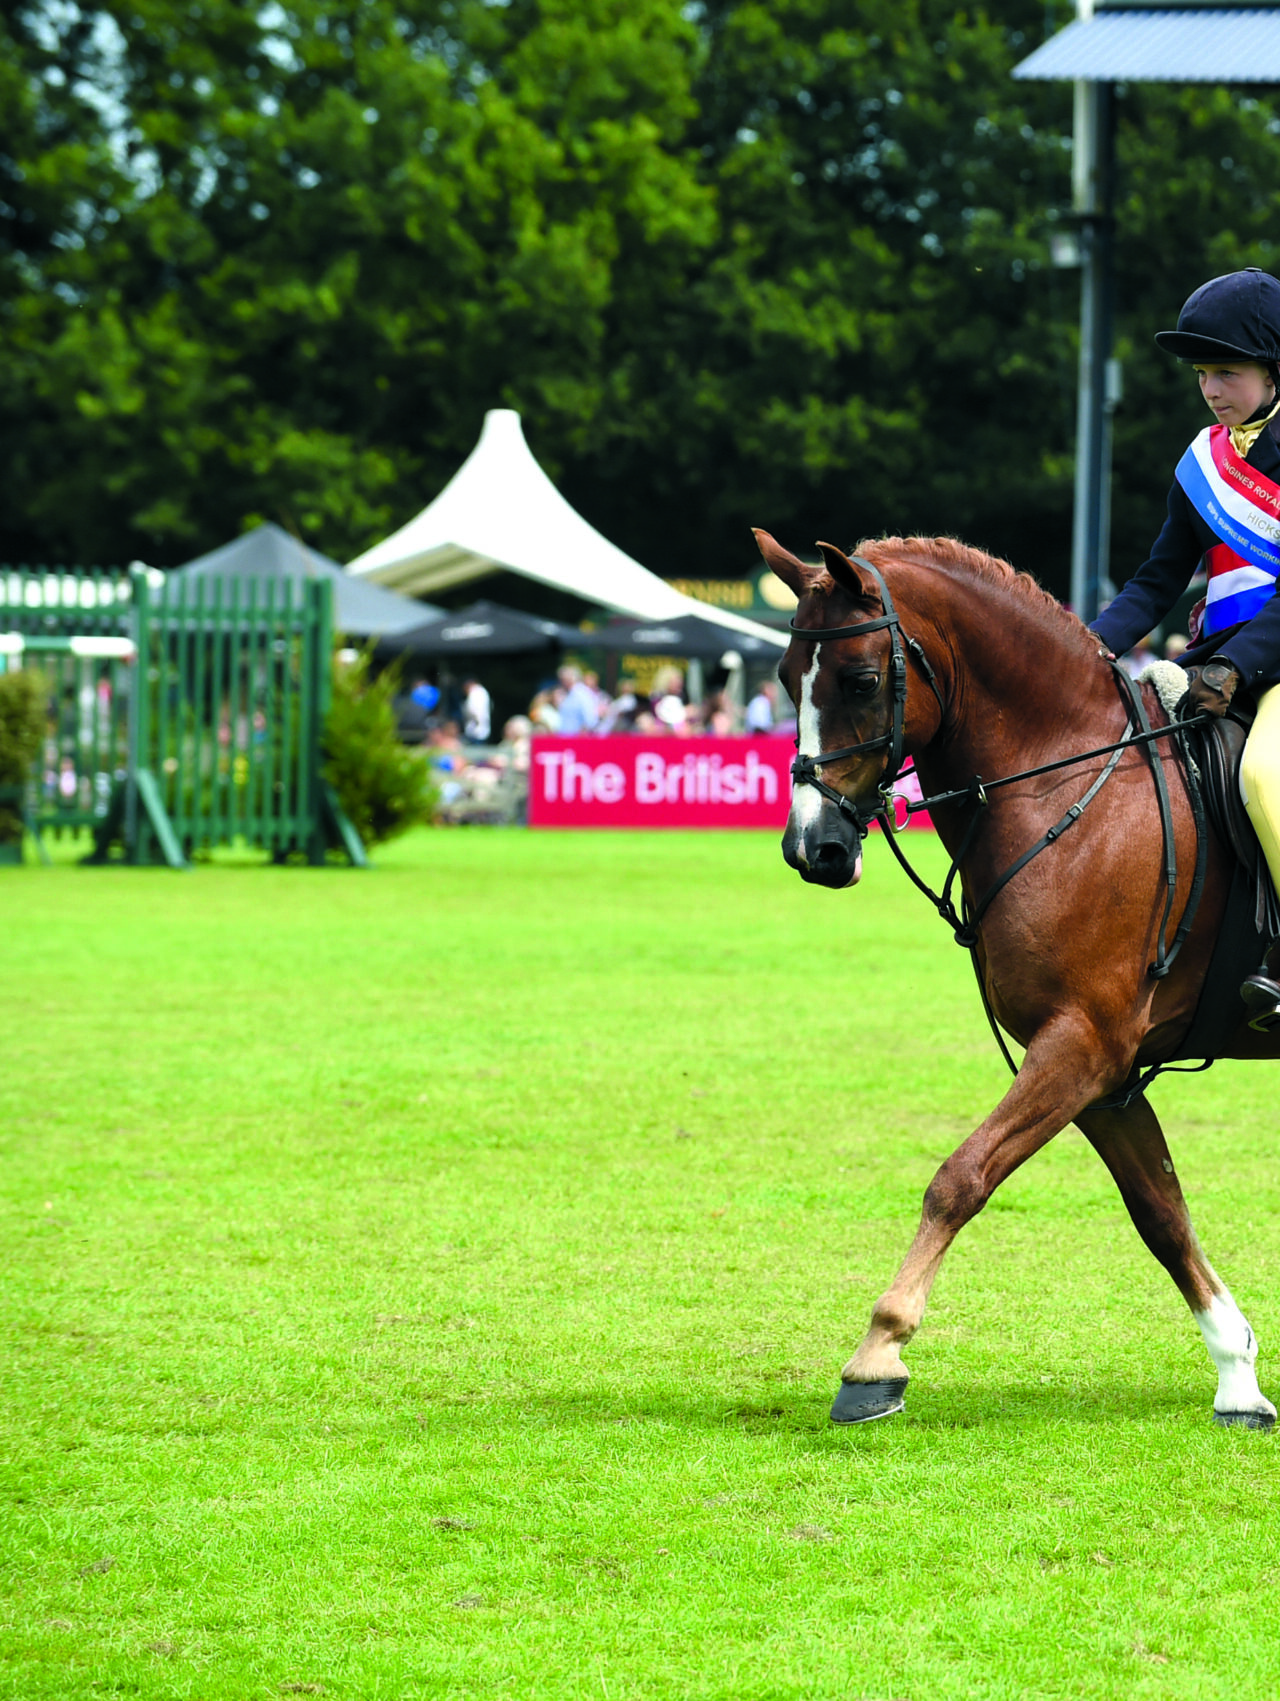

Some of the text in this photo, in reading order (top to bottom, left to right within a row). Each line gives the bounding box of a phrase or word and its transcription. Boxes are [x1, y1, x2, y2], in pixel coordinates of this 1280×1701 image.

[1253, 485, 1280, 510] ROYAL
[1217, 517, 1249, 547] SUPREME
[536, 750, 625, 803] The
[635, 750, 778, 803] British
